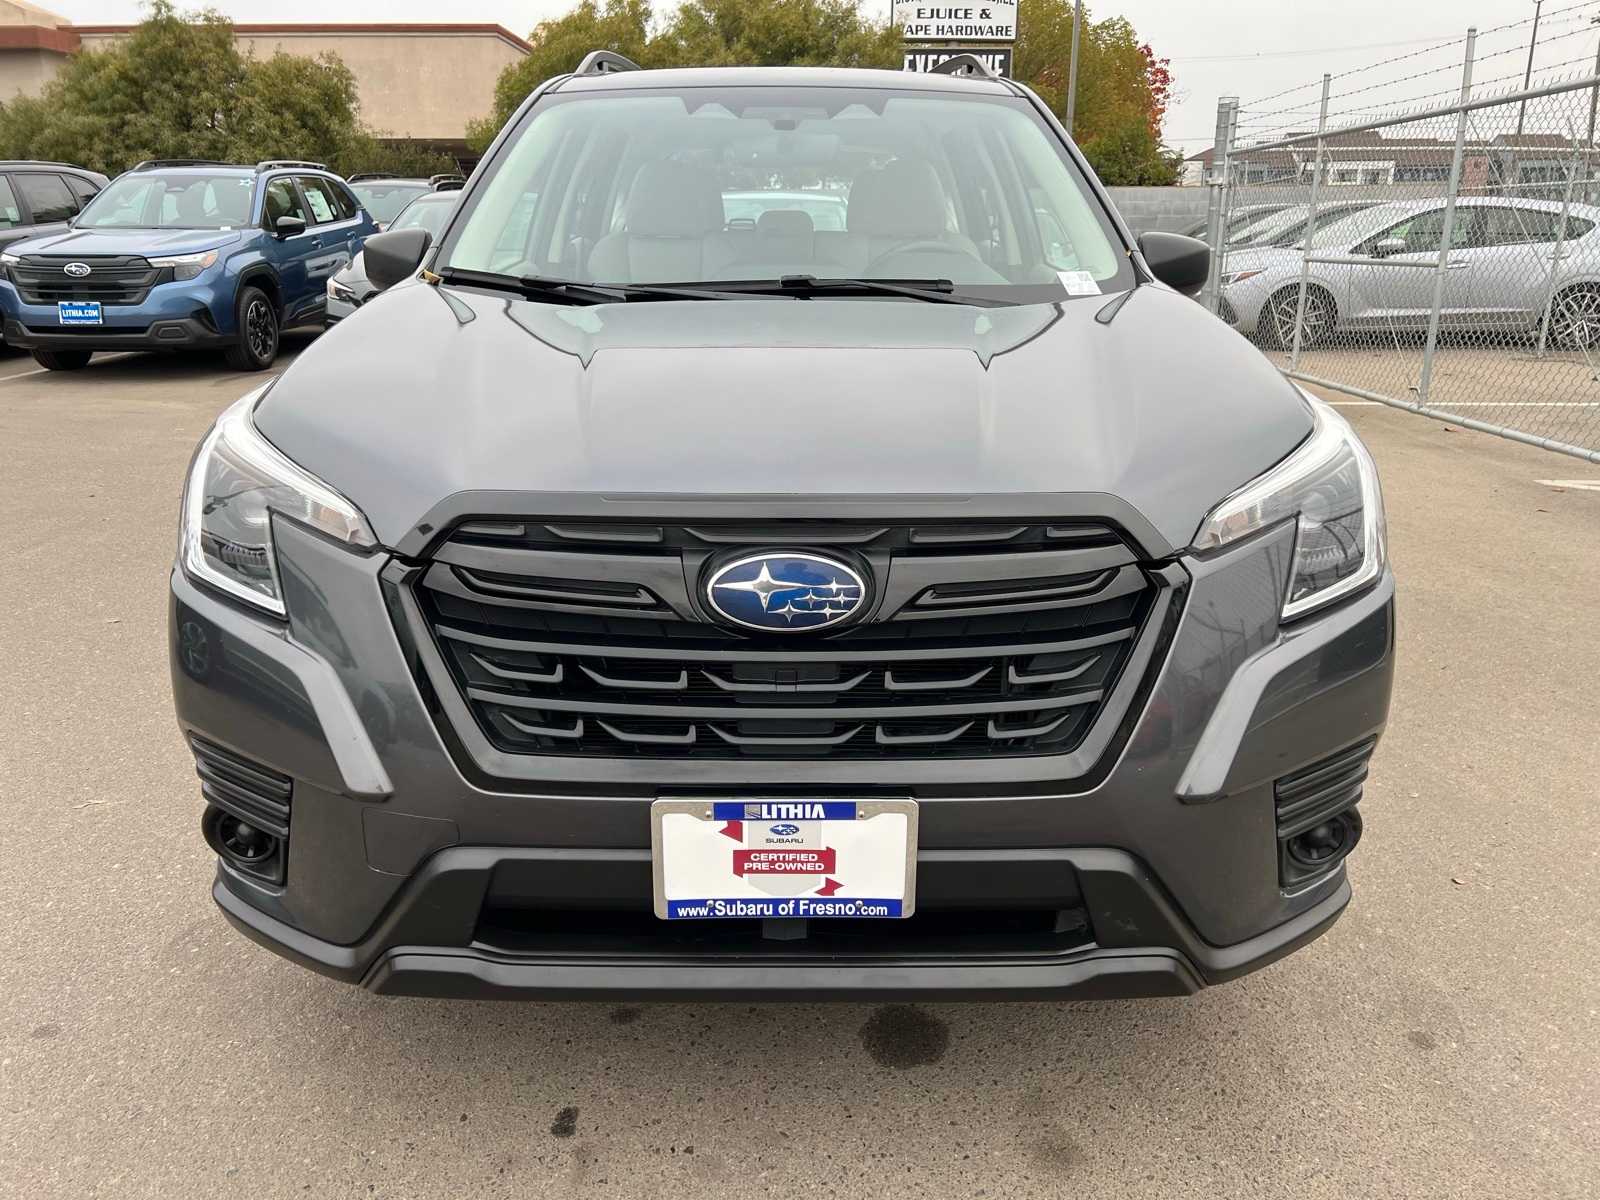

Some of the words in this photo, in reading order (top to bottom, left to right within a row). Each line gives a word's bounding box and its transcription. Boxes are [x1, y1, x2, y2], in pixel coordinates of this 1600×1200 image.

[917, 8, 973, 19] EJUICE
[979, 8, 993, 19] &
[904, 25, 931, 36] APE
[936, 25, 1012, 37] HARDWARE
[761, 803, 826, 819] LITHIA
[750, 853, 818, 861] CERTIFIED
[744, 862, 825, 871] PRE-OWNED
[778, 901, 795, 915] of
